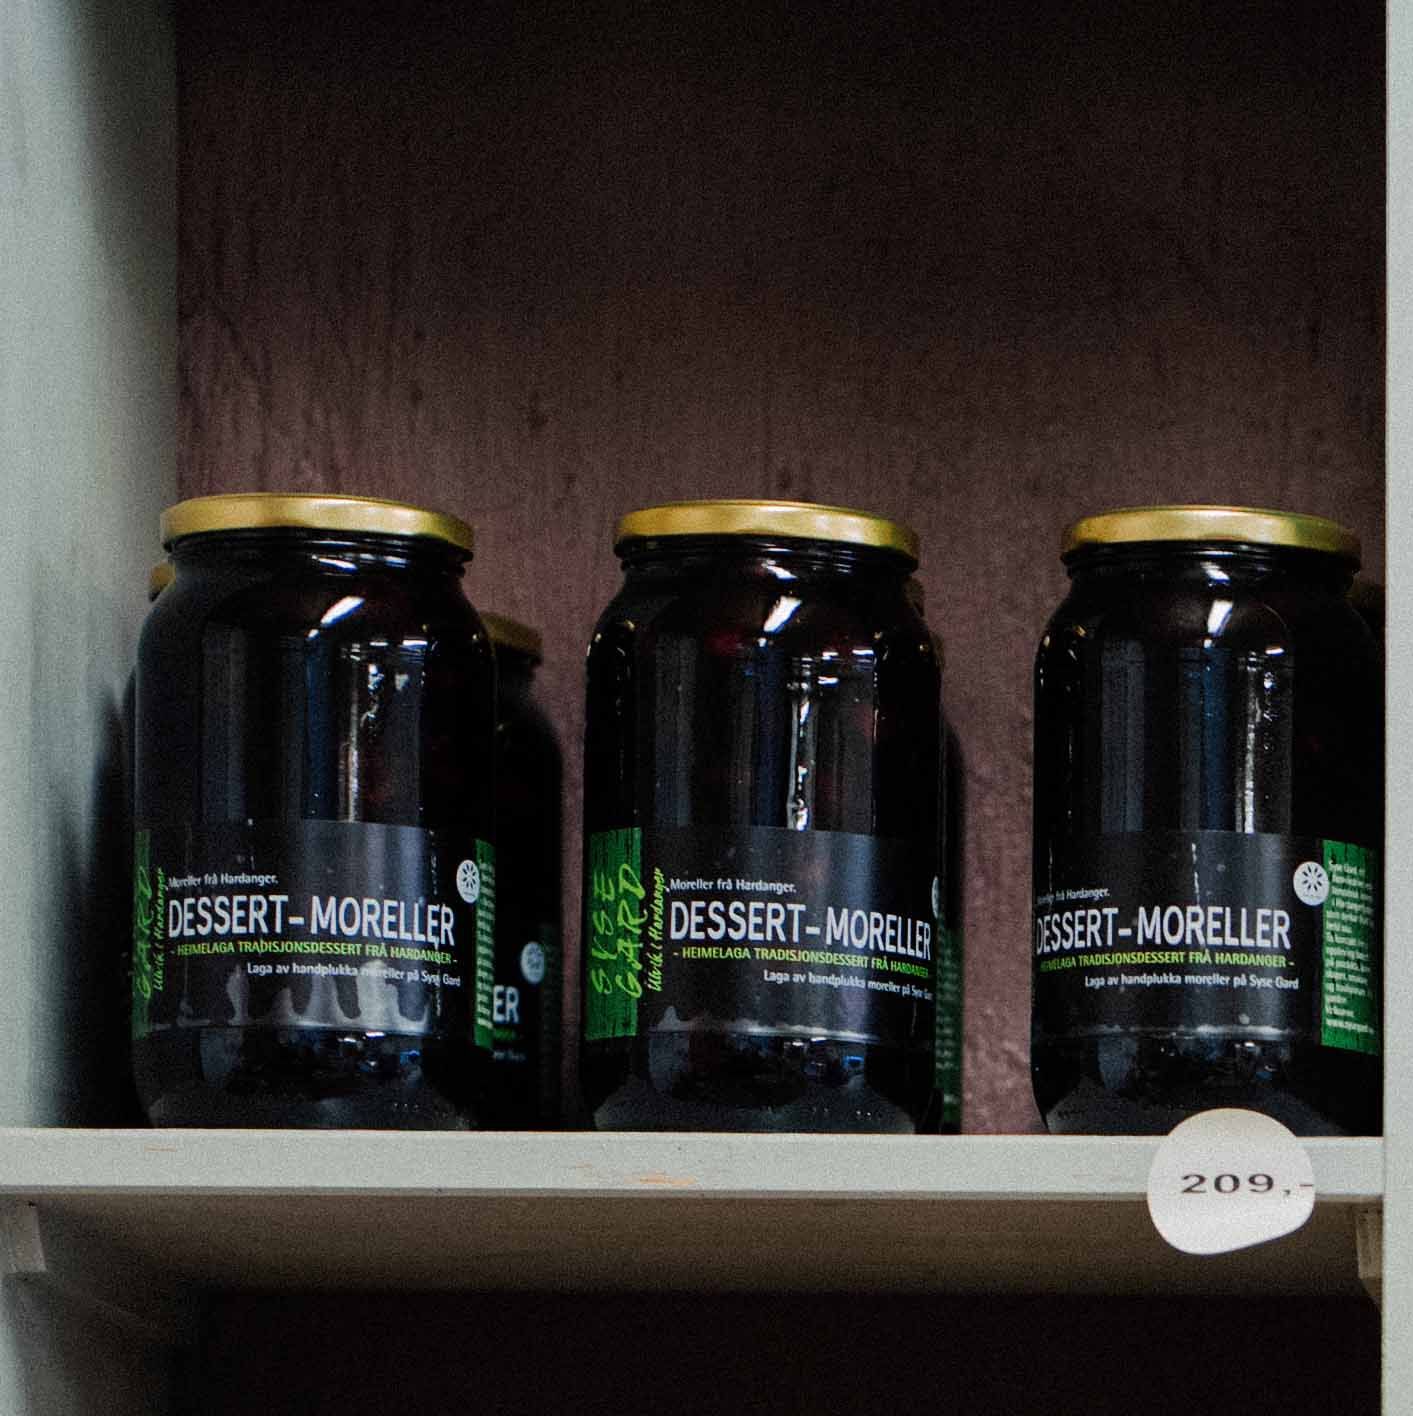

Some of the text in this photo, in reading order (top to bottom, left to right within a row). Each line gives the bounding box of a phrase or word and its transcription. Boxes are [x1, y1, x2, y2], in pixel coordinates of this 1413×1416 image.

[220, 872, 279, 887] Hardanger.
[669, 878, 797, 896] Moreller frå Hardanger.
[239, 939, 361, 956] TRADISJONSDESSERT
[366, 942, 388, 958] FRÅ
[682, 947, 751, 960] HEIMELAGA
[755, 947, 869, 969] TRADISJONSDESSERT
[1079, 952, 1186, 967] TRADISJONSDESSERT
[1189, 949, 1212, 965] FRÅ
[1215, 951, 1287, 967] HARDANGER
[247, 962, 272, 975] Laga
[276, 965, 290, 974] av
[292, 962, 358, 978] handplukka
[764, 968, 790, 985] Laga
[793, 973, 806, 984] av
[1085, 975, 1106, 990] Laga
[1121, 973, 1182, 988] handplukka
[1184, 974, 1231, 986] moreller
[1233, 975, 1248, 989] på
[1249, 976, 1273, 991] Syse
[1181, 1173, 1314, 1196] 209,-
